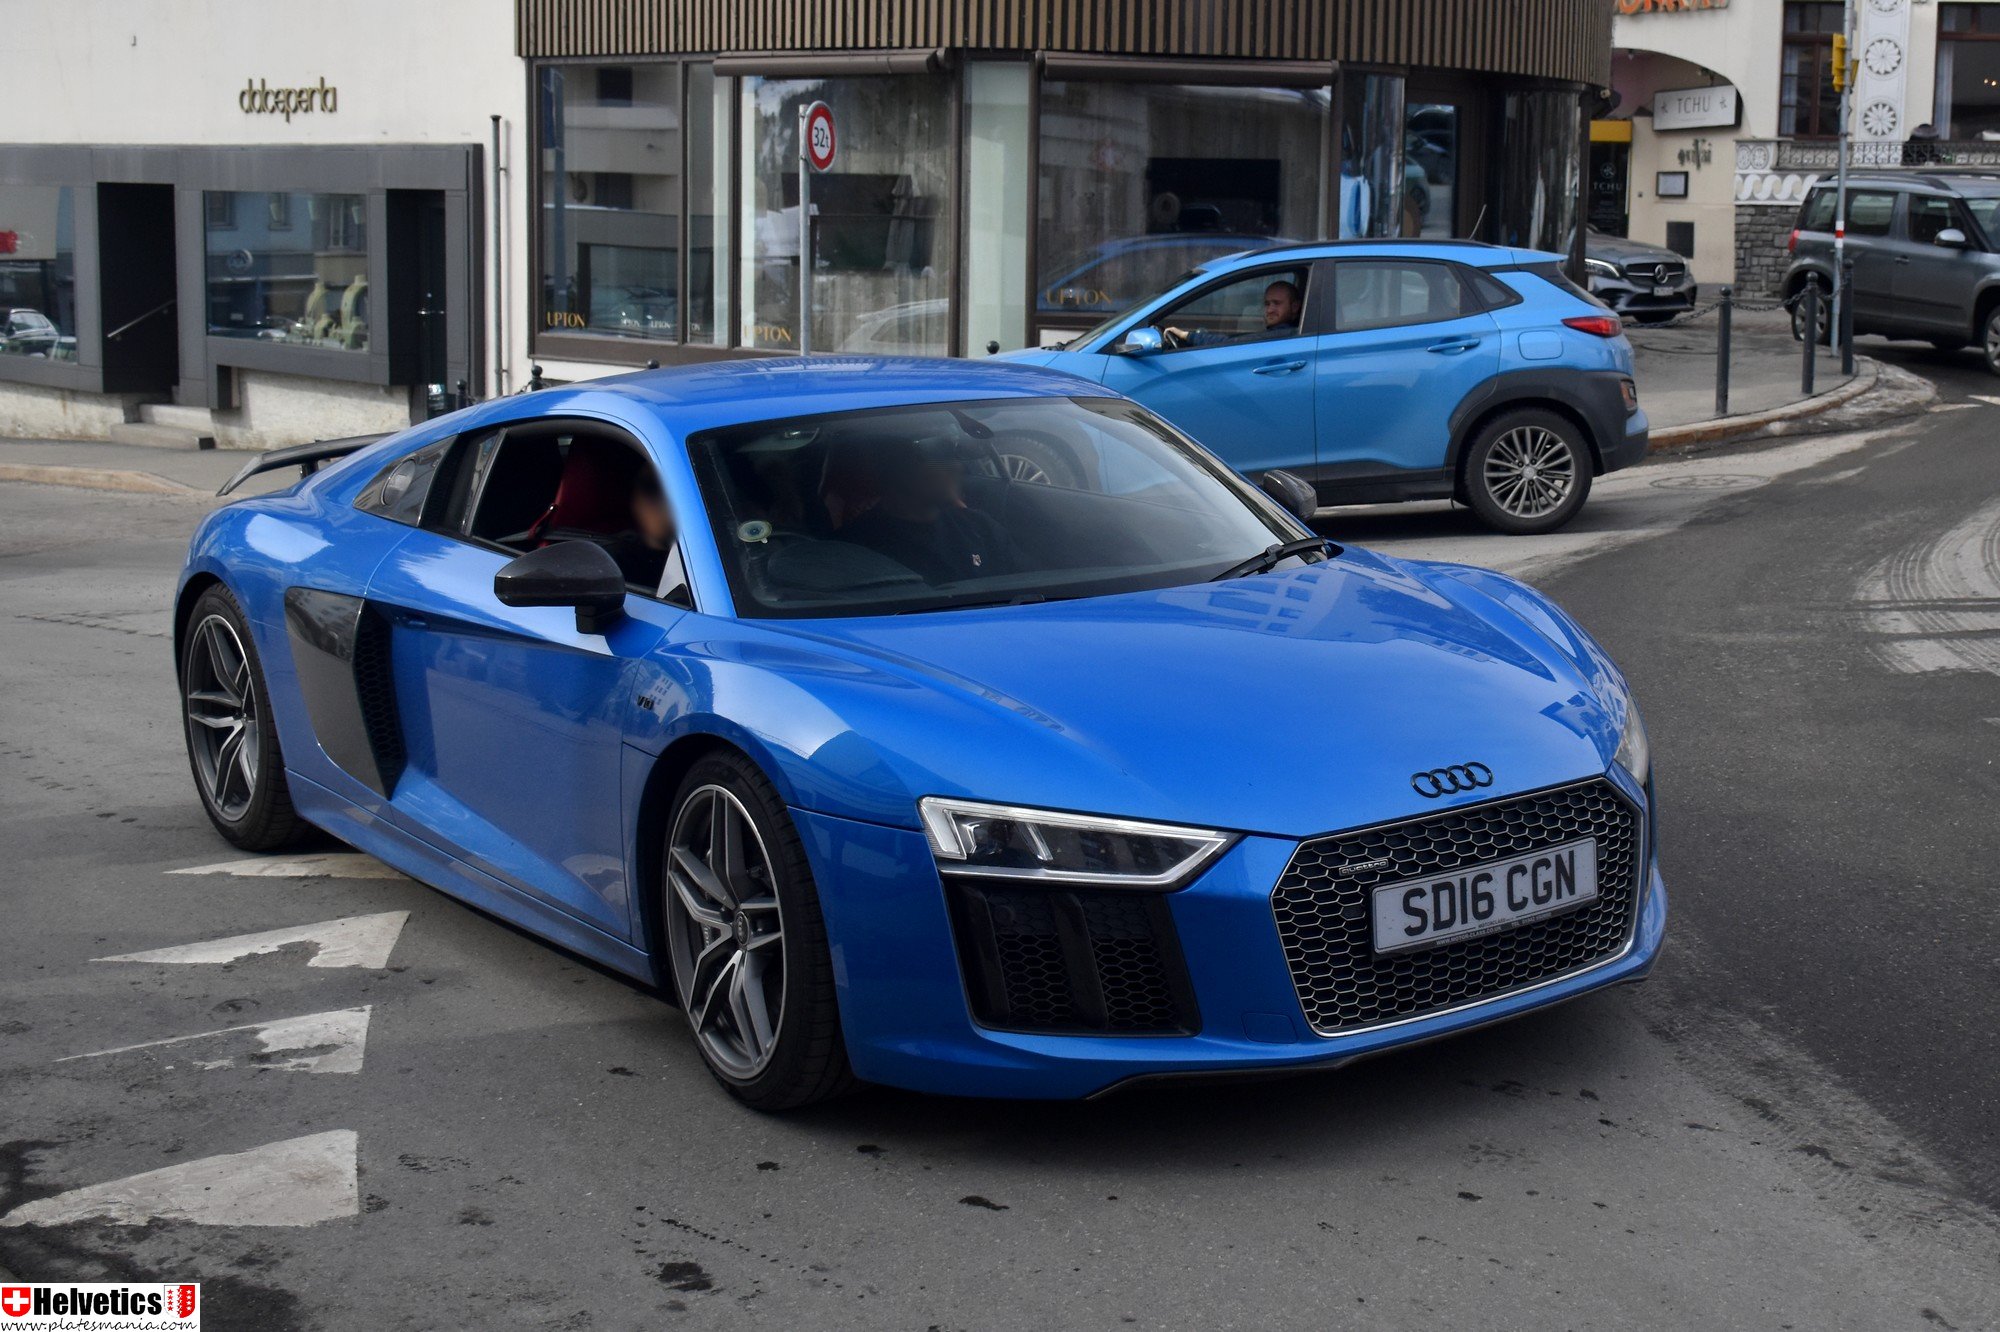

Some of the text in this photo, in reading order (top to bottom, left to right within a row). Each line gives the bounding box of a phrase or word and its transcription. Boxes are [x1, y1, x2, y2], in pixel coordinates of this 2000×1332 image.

[1677, 95, 1711, 114] TCHU
[1594, 182, 1621, 191] TCHU
[546, 312, 585, 327] UPTON
[1341, 861, 1387, 875] quattro
[1402, 850, 1576, 937] SD16 CGN
